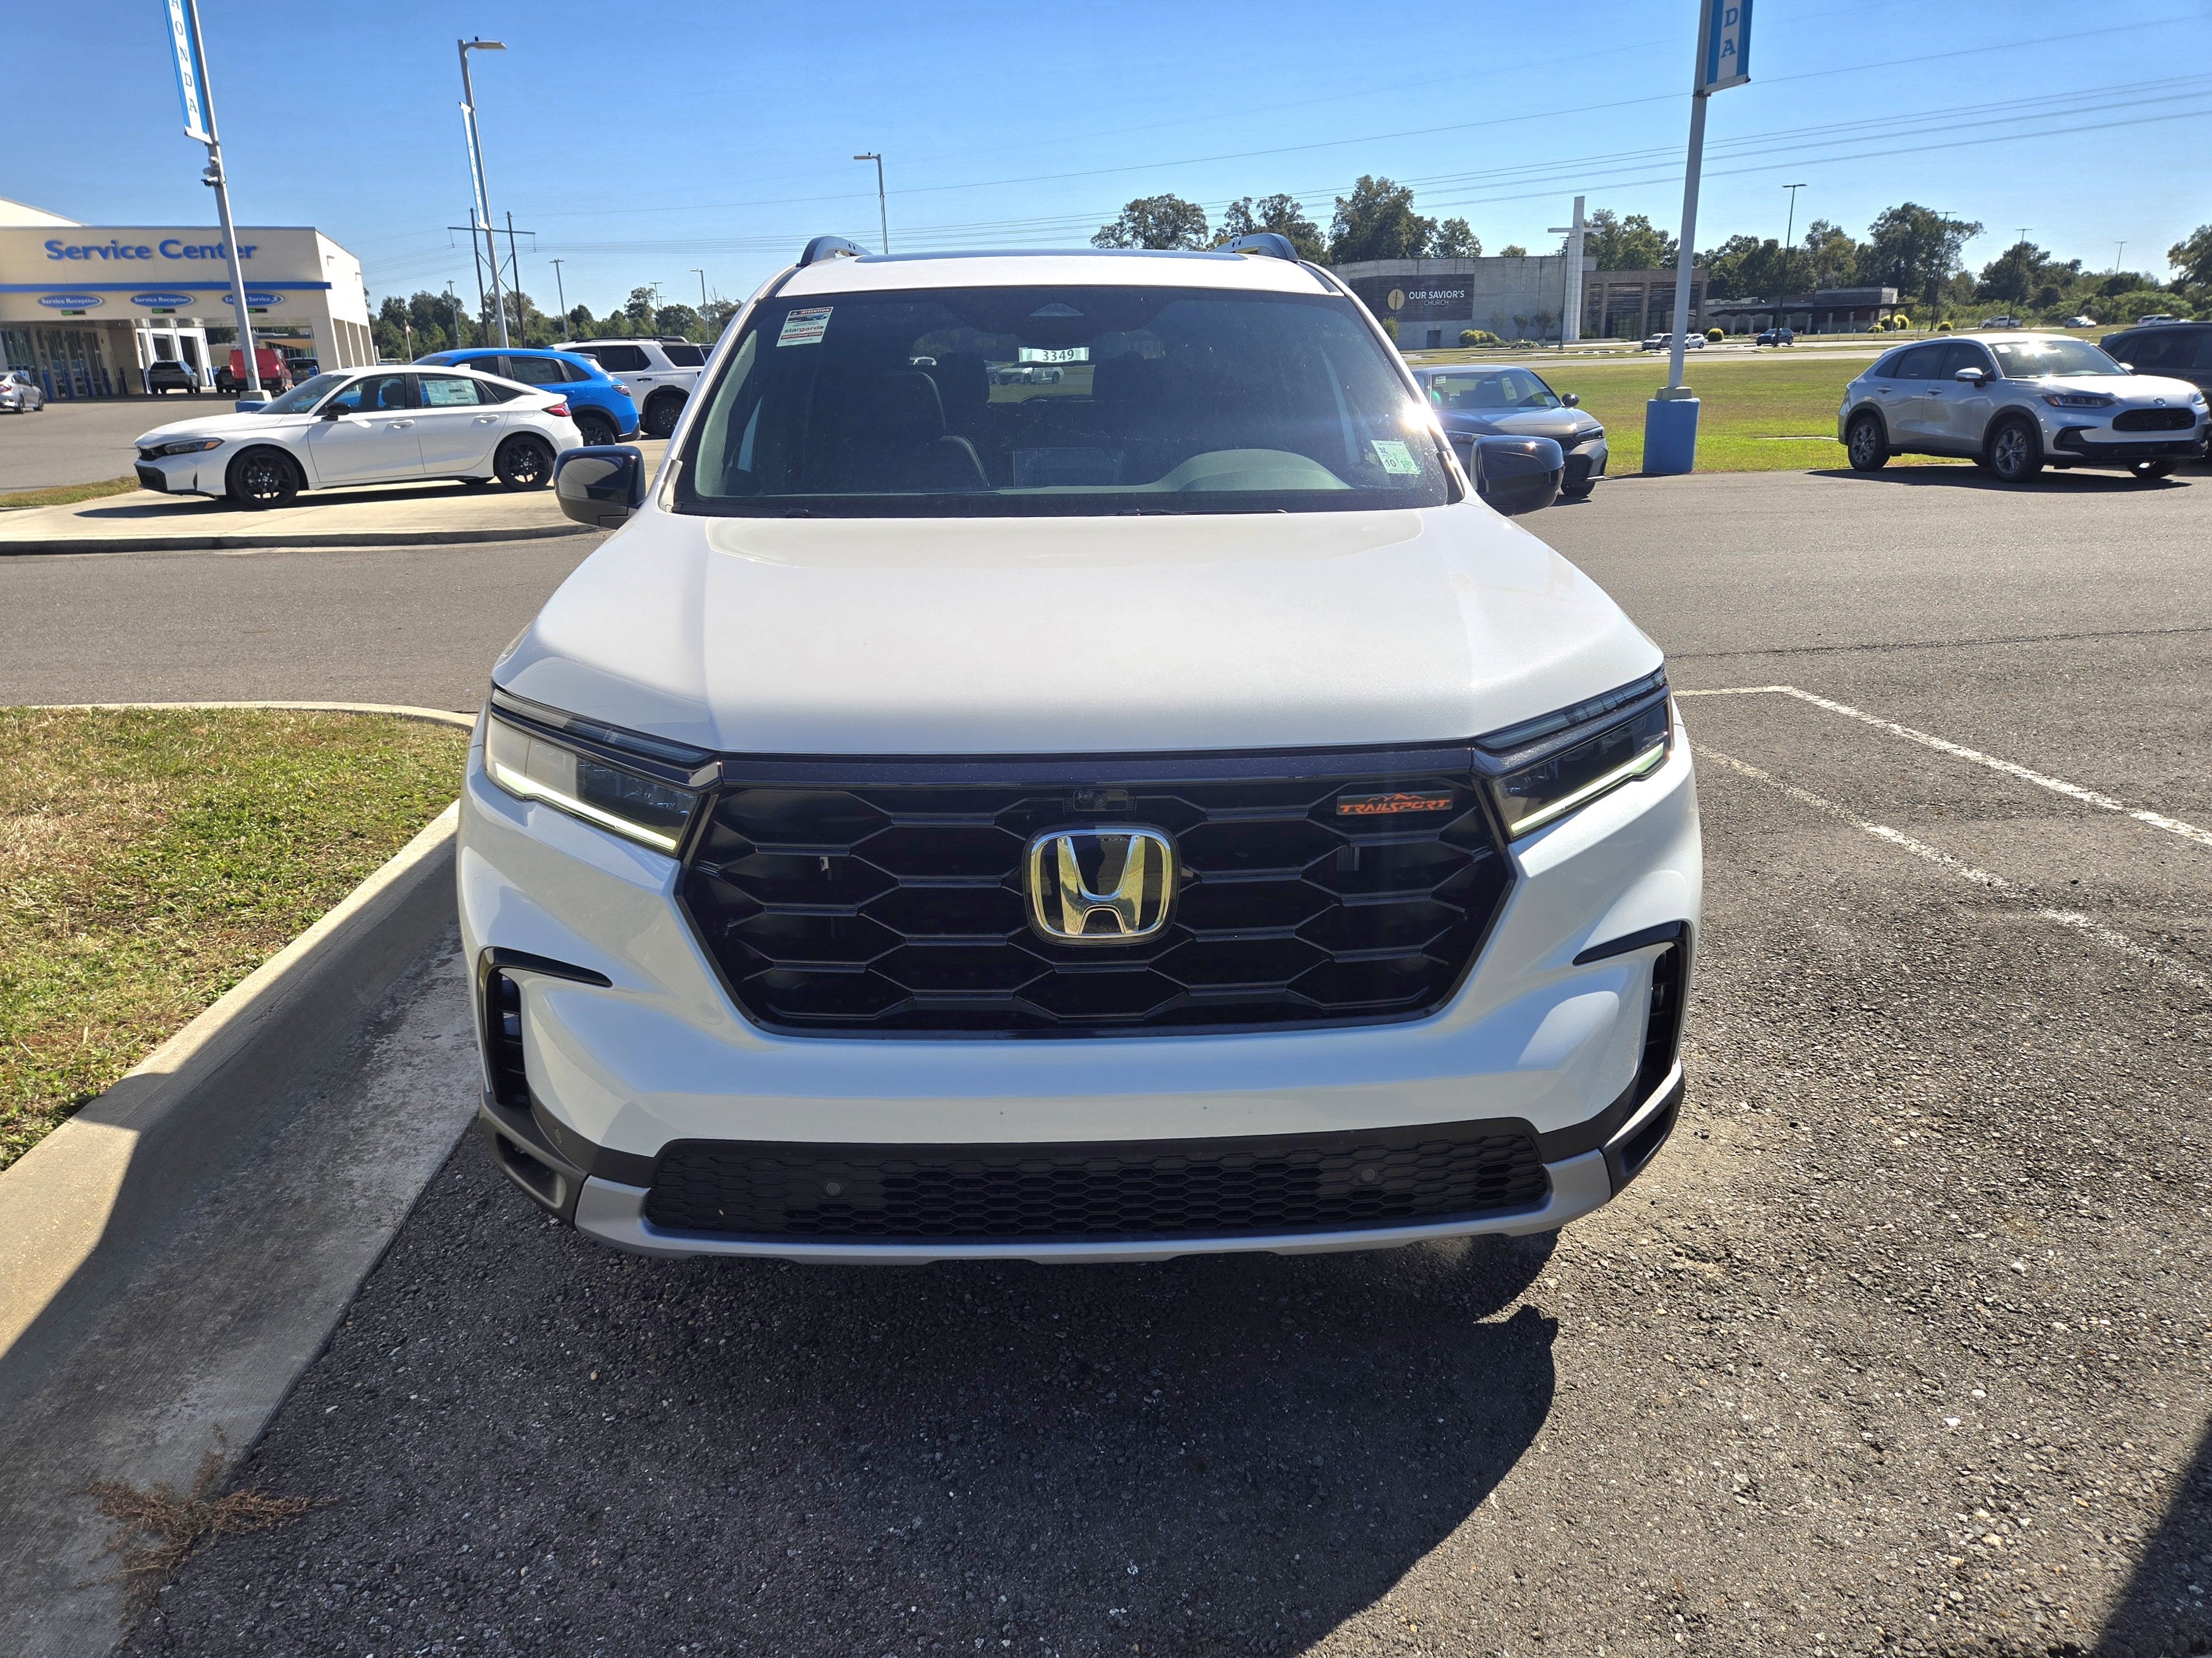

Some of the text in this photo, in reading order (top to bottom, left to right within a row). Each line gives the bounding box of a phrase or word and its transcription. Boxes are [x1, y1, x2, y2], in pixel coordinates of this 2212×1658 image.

[1721, 7, 1738, 58] DA
[172, 0, 198, 114] HONDA
[44, 240, 152, 260] Service
[1409, 290, 1465, 299] OUR SAVIOR'S
[1042, 349, 1074, 361] 3349
[1385, 459, 1397, 467] 10
[1340, 799, 1451, 814] TRAILSPORT
